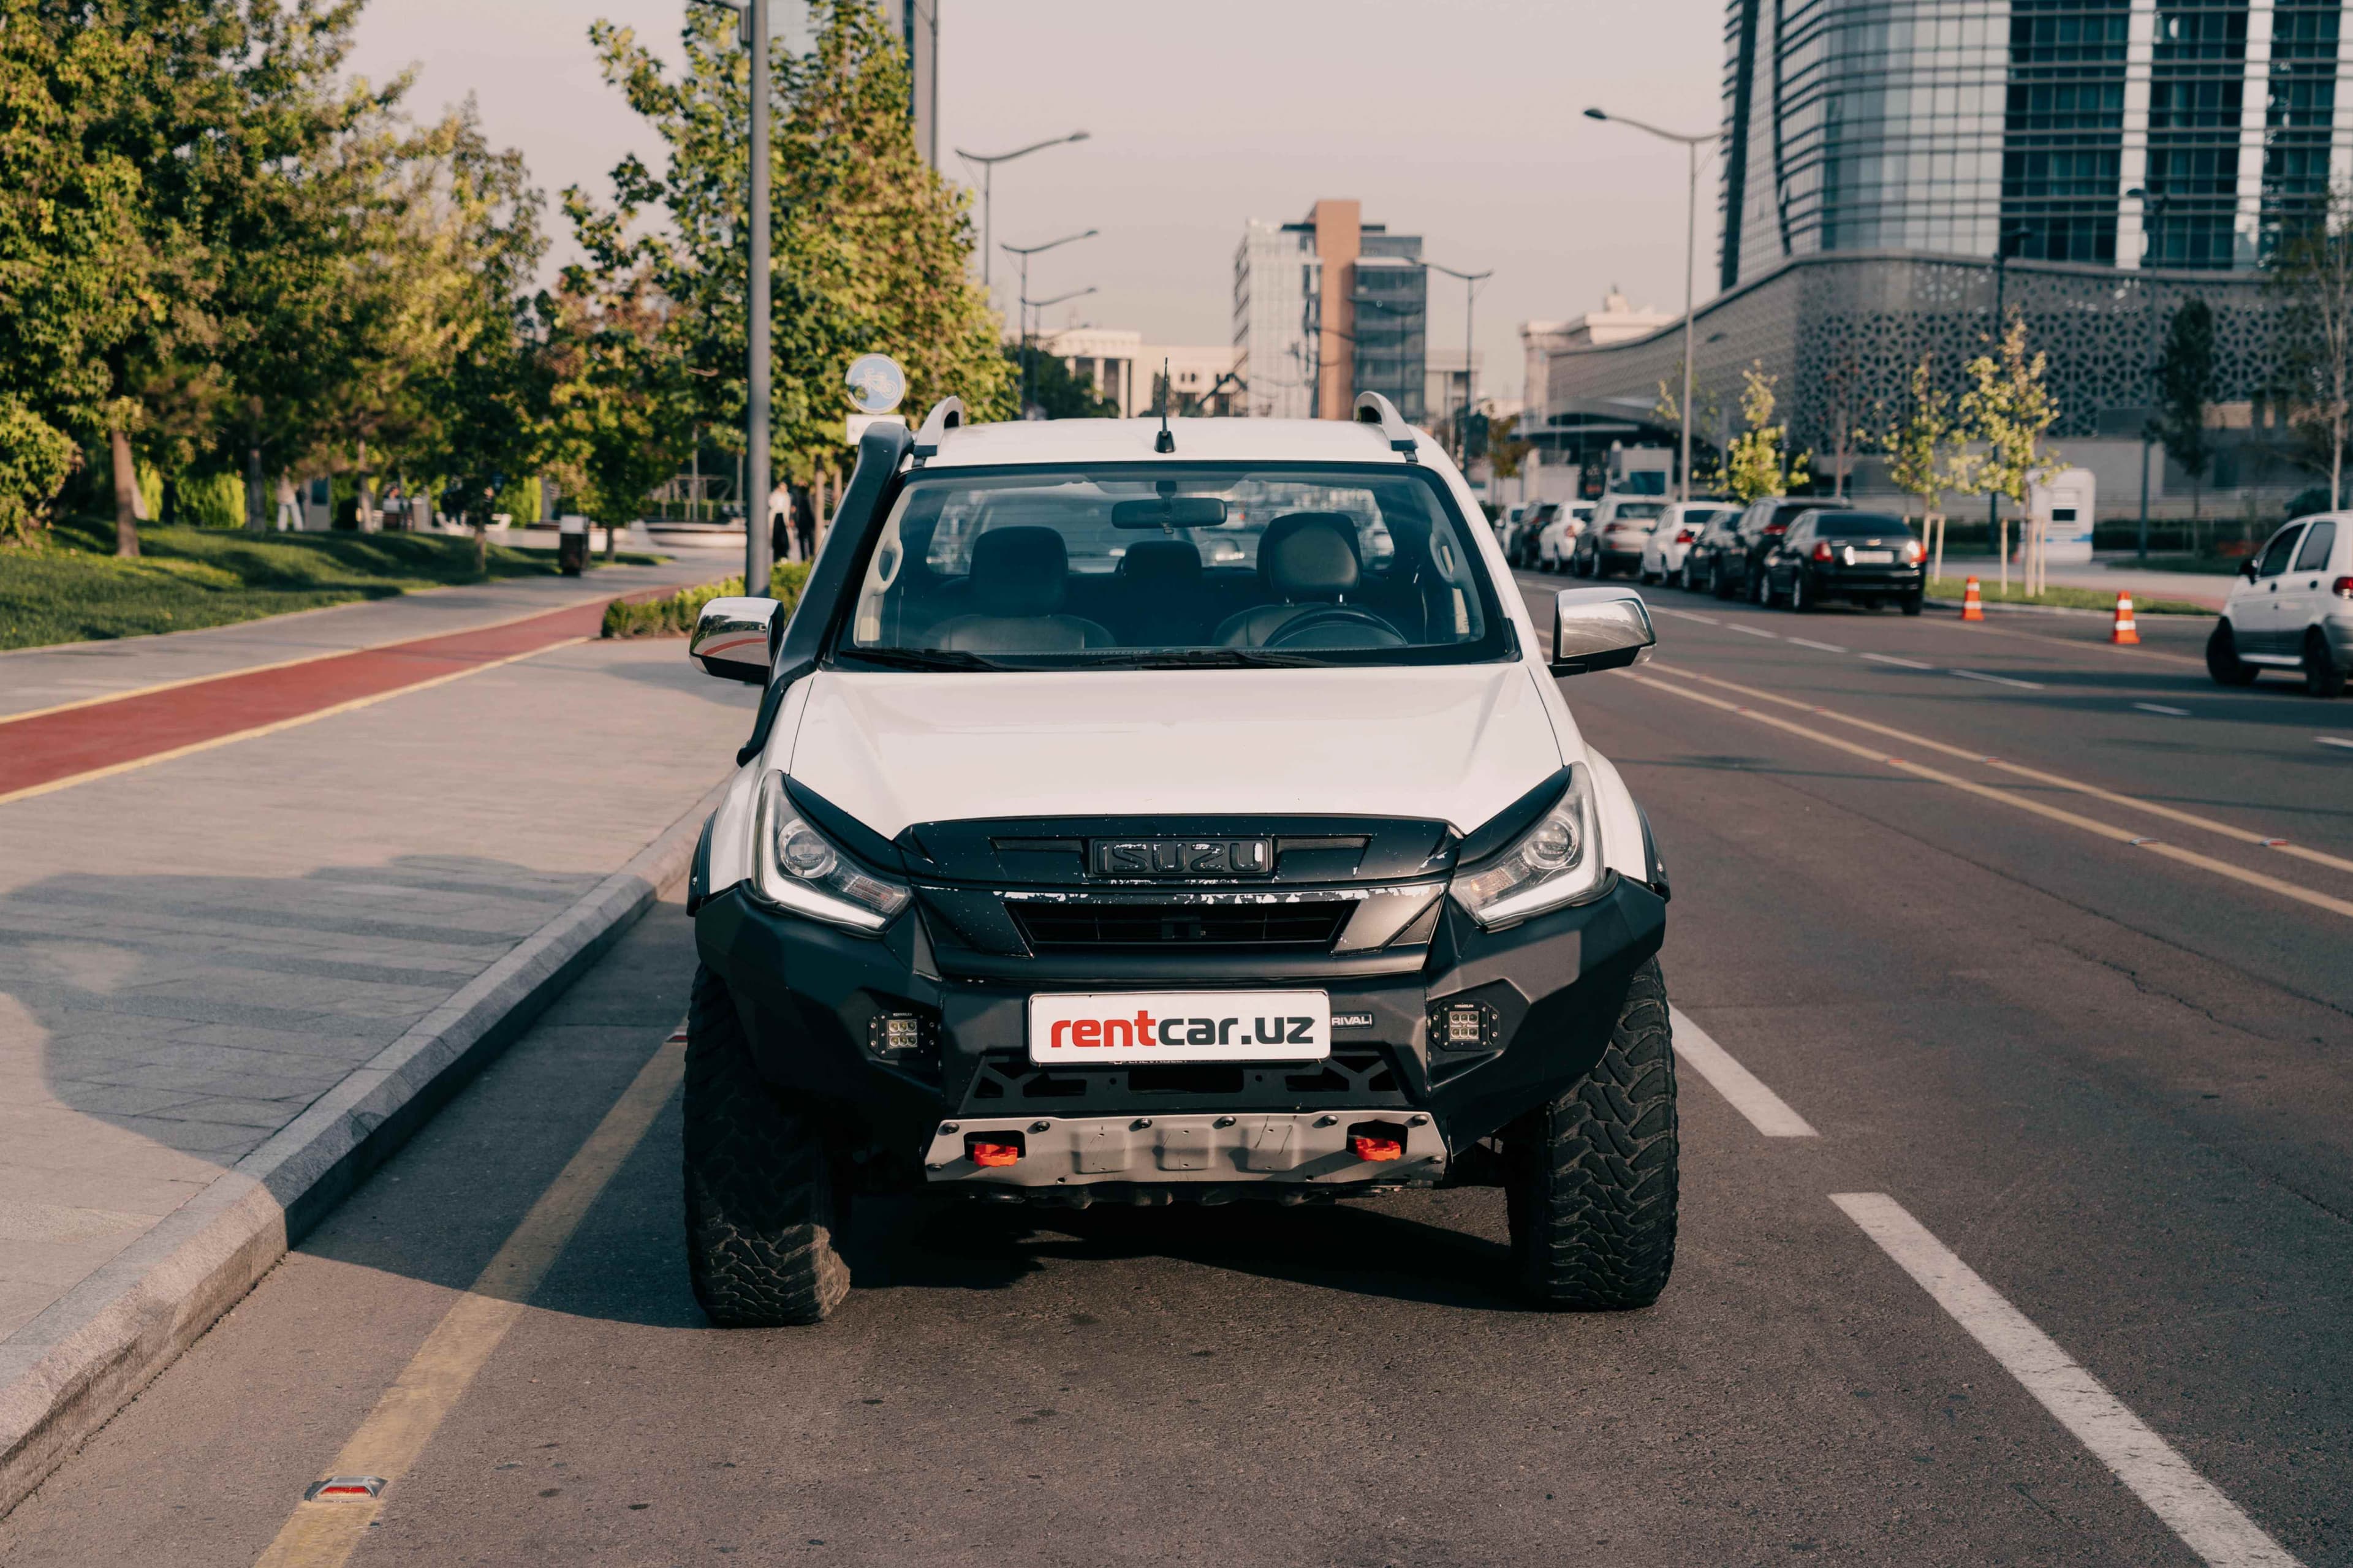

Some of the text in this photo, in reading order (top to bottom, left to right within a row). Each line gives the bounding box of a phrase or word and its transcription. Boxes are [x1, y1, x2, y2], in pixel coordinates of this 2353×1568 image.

[1097, 843, 1264, 872] ISUZU
[1051, 1010, 1315, 1048] rentcar.uz
[1331, 1015, 1370, 1025] RIVAL
